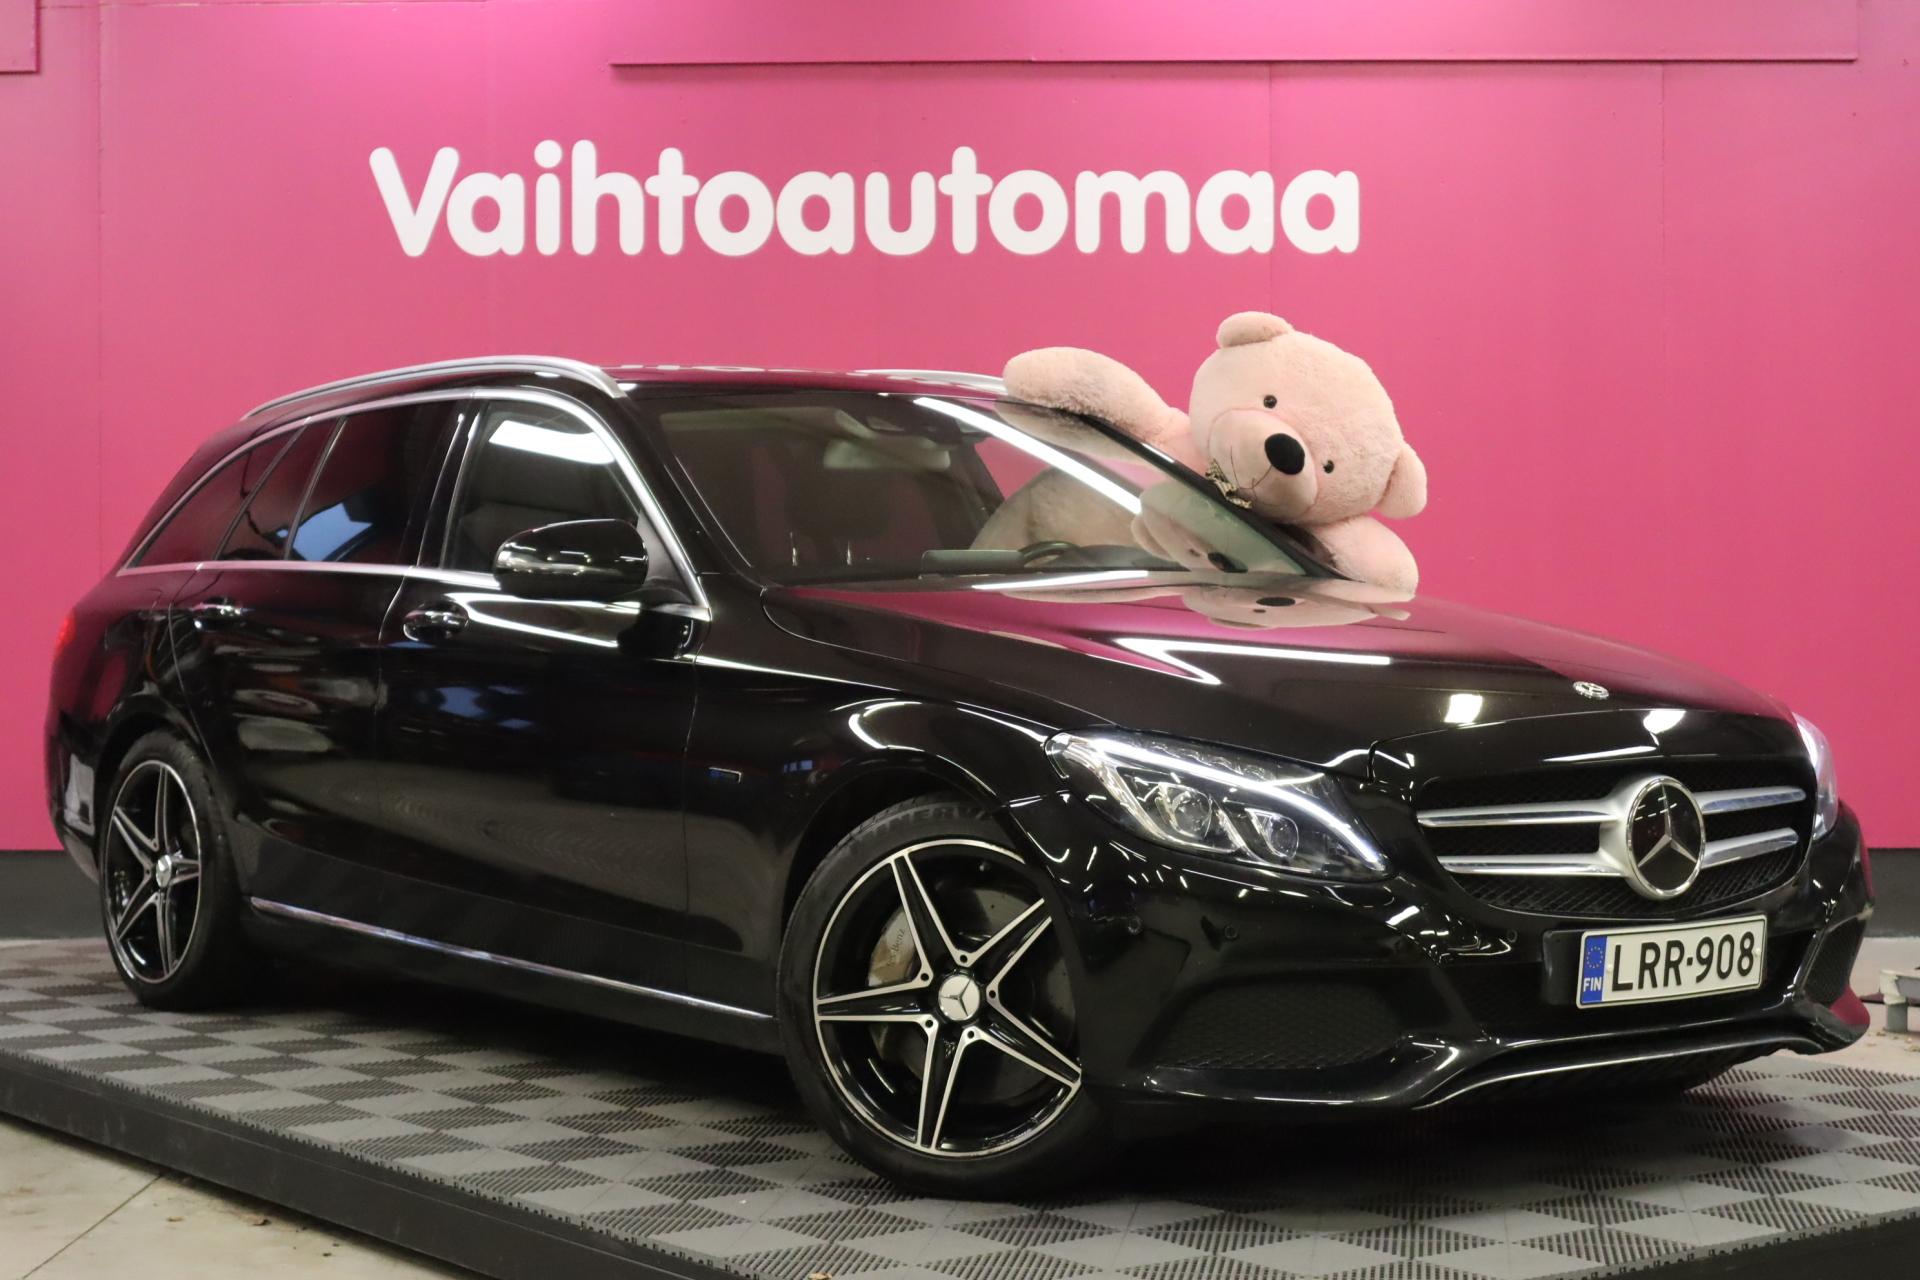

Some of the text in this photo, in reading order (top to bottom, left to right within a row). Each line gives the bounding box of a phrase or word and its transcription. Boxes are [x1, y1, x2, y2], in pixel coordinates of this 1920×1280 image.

[369, 139, 1361, 257] Vaihtoautomaa
[1583, 977, 1602, 992] FIN
[1611, 931, 1755, 992] LRR-908
